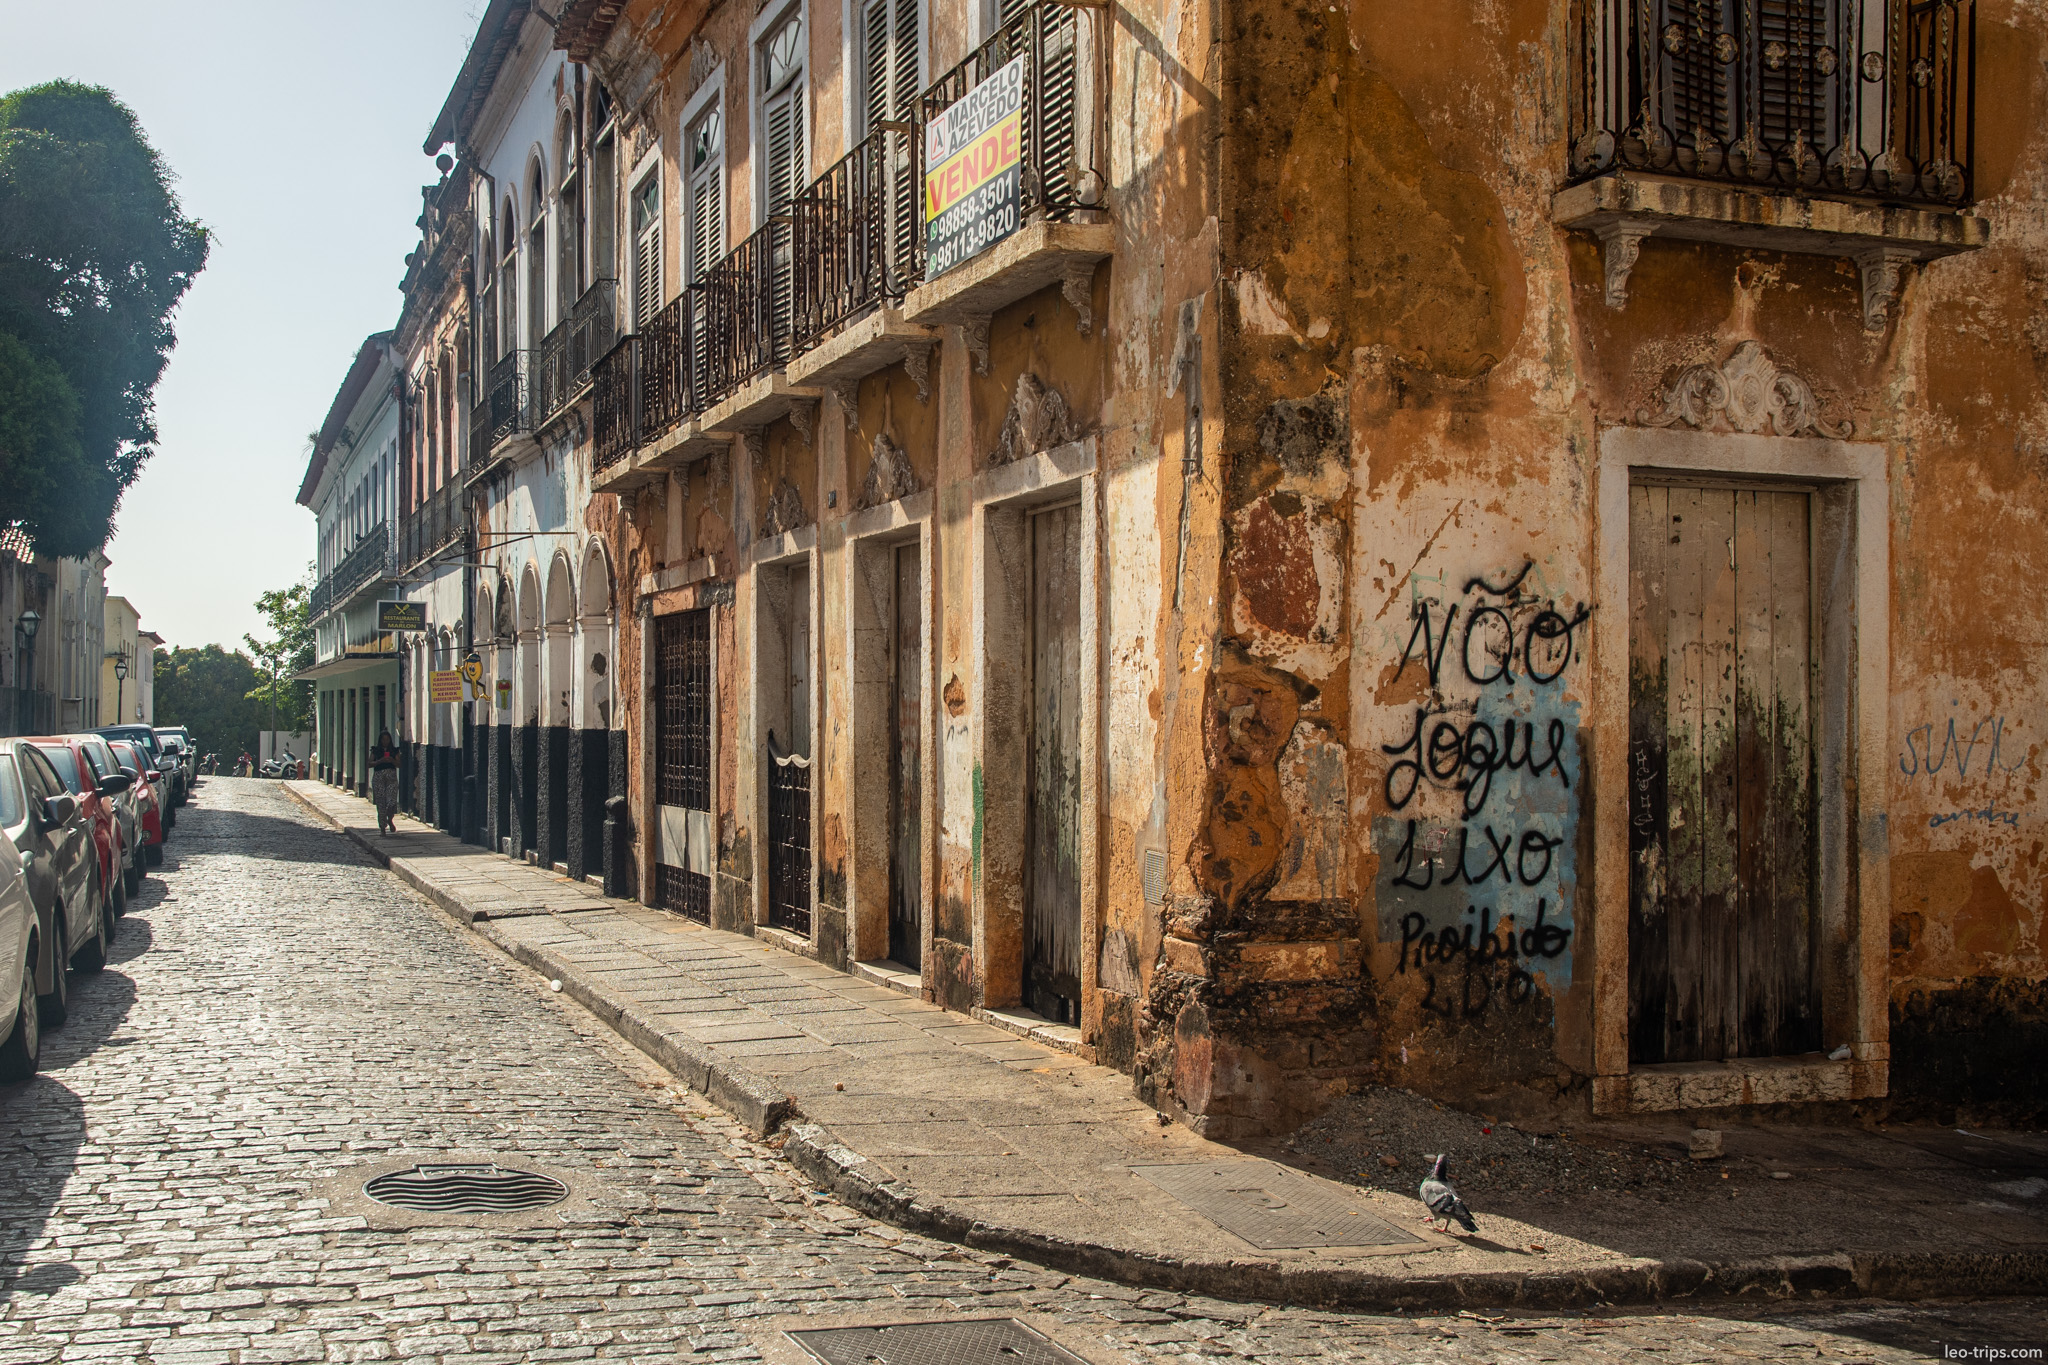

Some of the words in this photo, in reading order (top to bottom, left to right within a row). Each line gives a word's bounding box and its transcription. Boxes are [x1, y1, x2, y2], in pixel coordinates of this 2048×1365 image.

[948, 62, 1019, 133] MARCELO
[949, 87, 1019, 155] AZEVEDO
[929, 119, 1018, 213] VENDE
[937, 203, 1013, 272] 98113-9820
[938, 171, 1013, 242] 98858-3501
